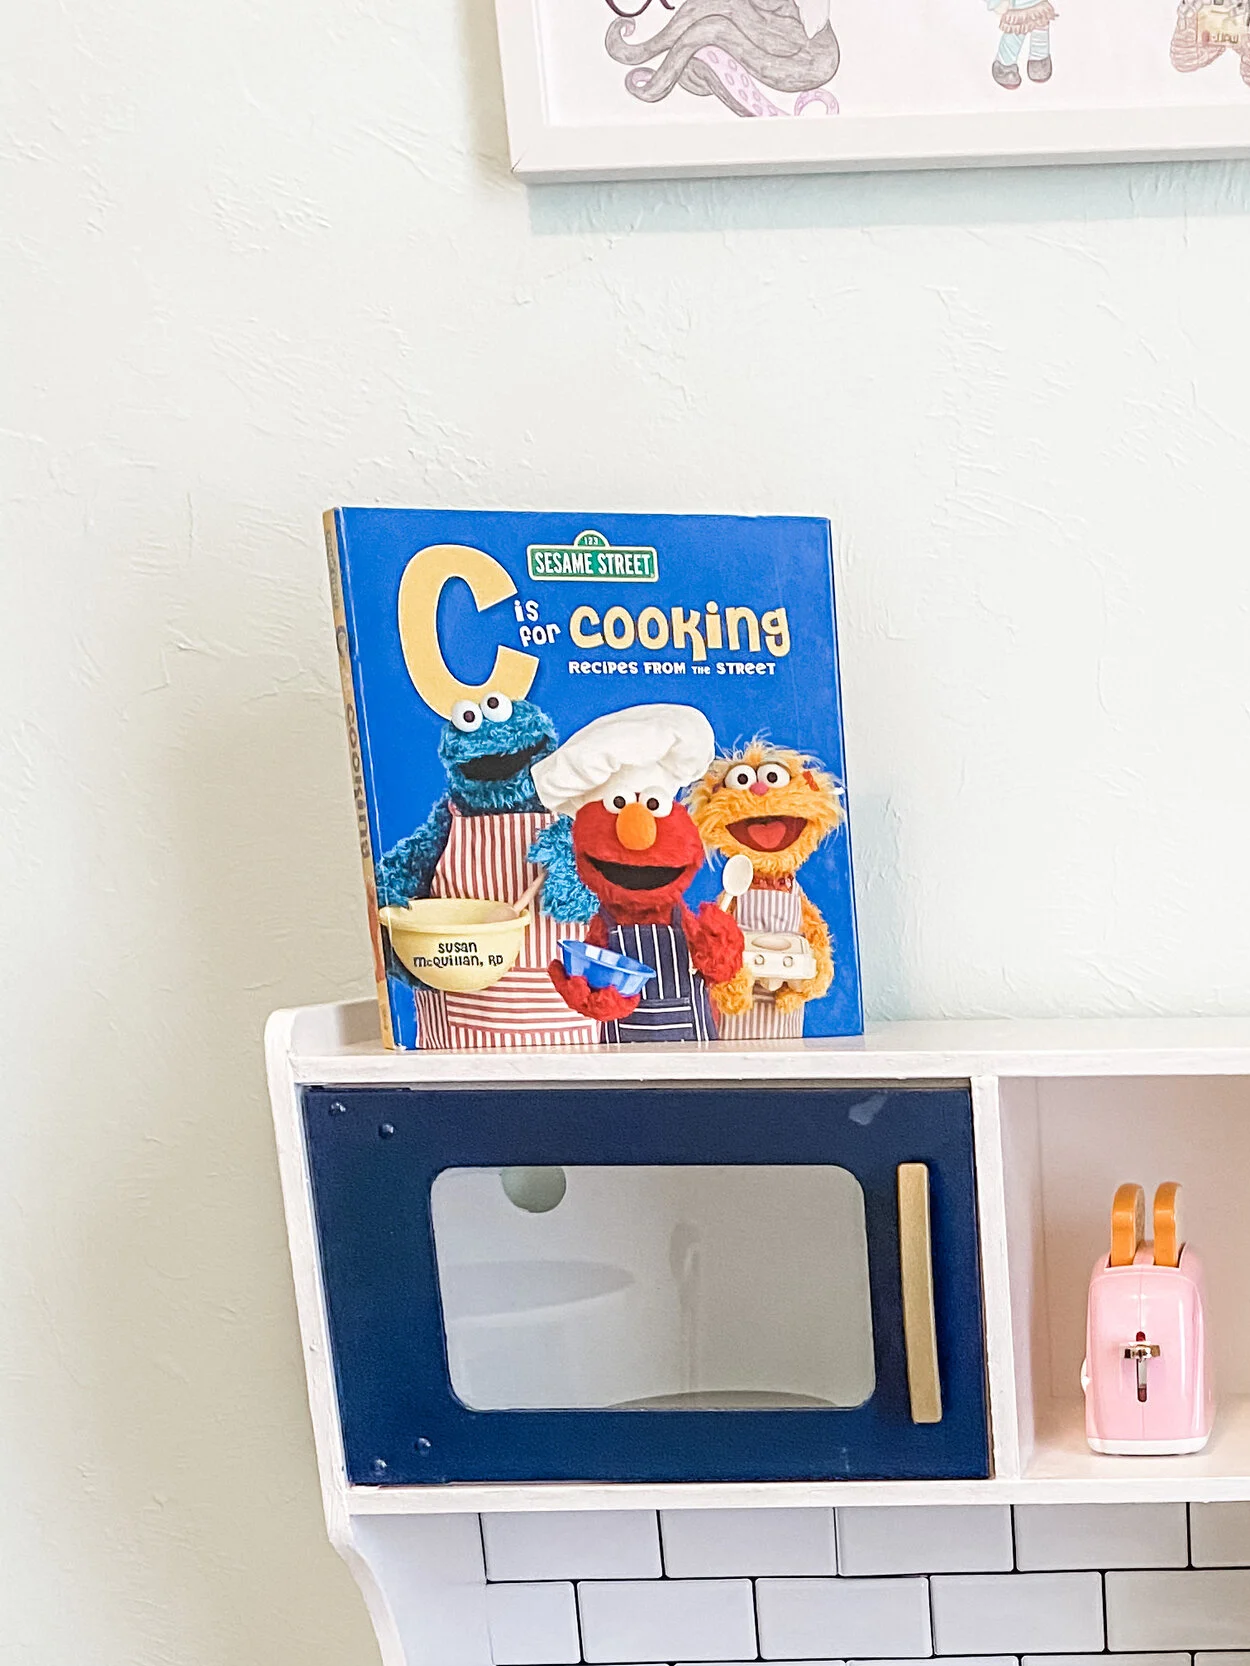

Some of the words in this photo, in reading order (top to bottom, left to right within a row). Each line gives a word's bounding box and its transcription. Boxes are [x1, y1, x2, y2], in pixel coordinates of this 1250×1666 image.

[584, 536, 599, 545] 123
[535, 552, 594, 574] SESAME
[597, 553, 651, 575] STREET
[513, 600, 539, 622] is
[397, 543, 540, 721] C
[519, 623, 561, 647] for
[643, 661, 686, 675] FROM
[488, 955, 503, 966] RD
